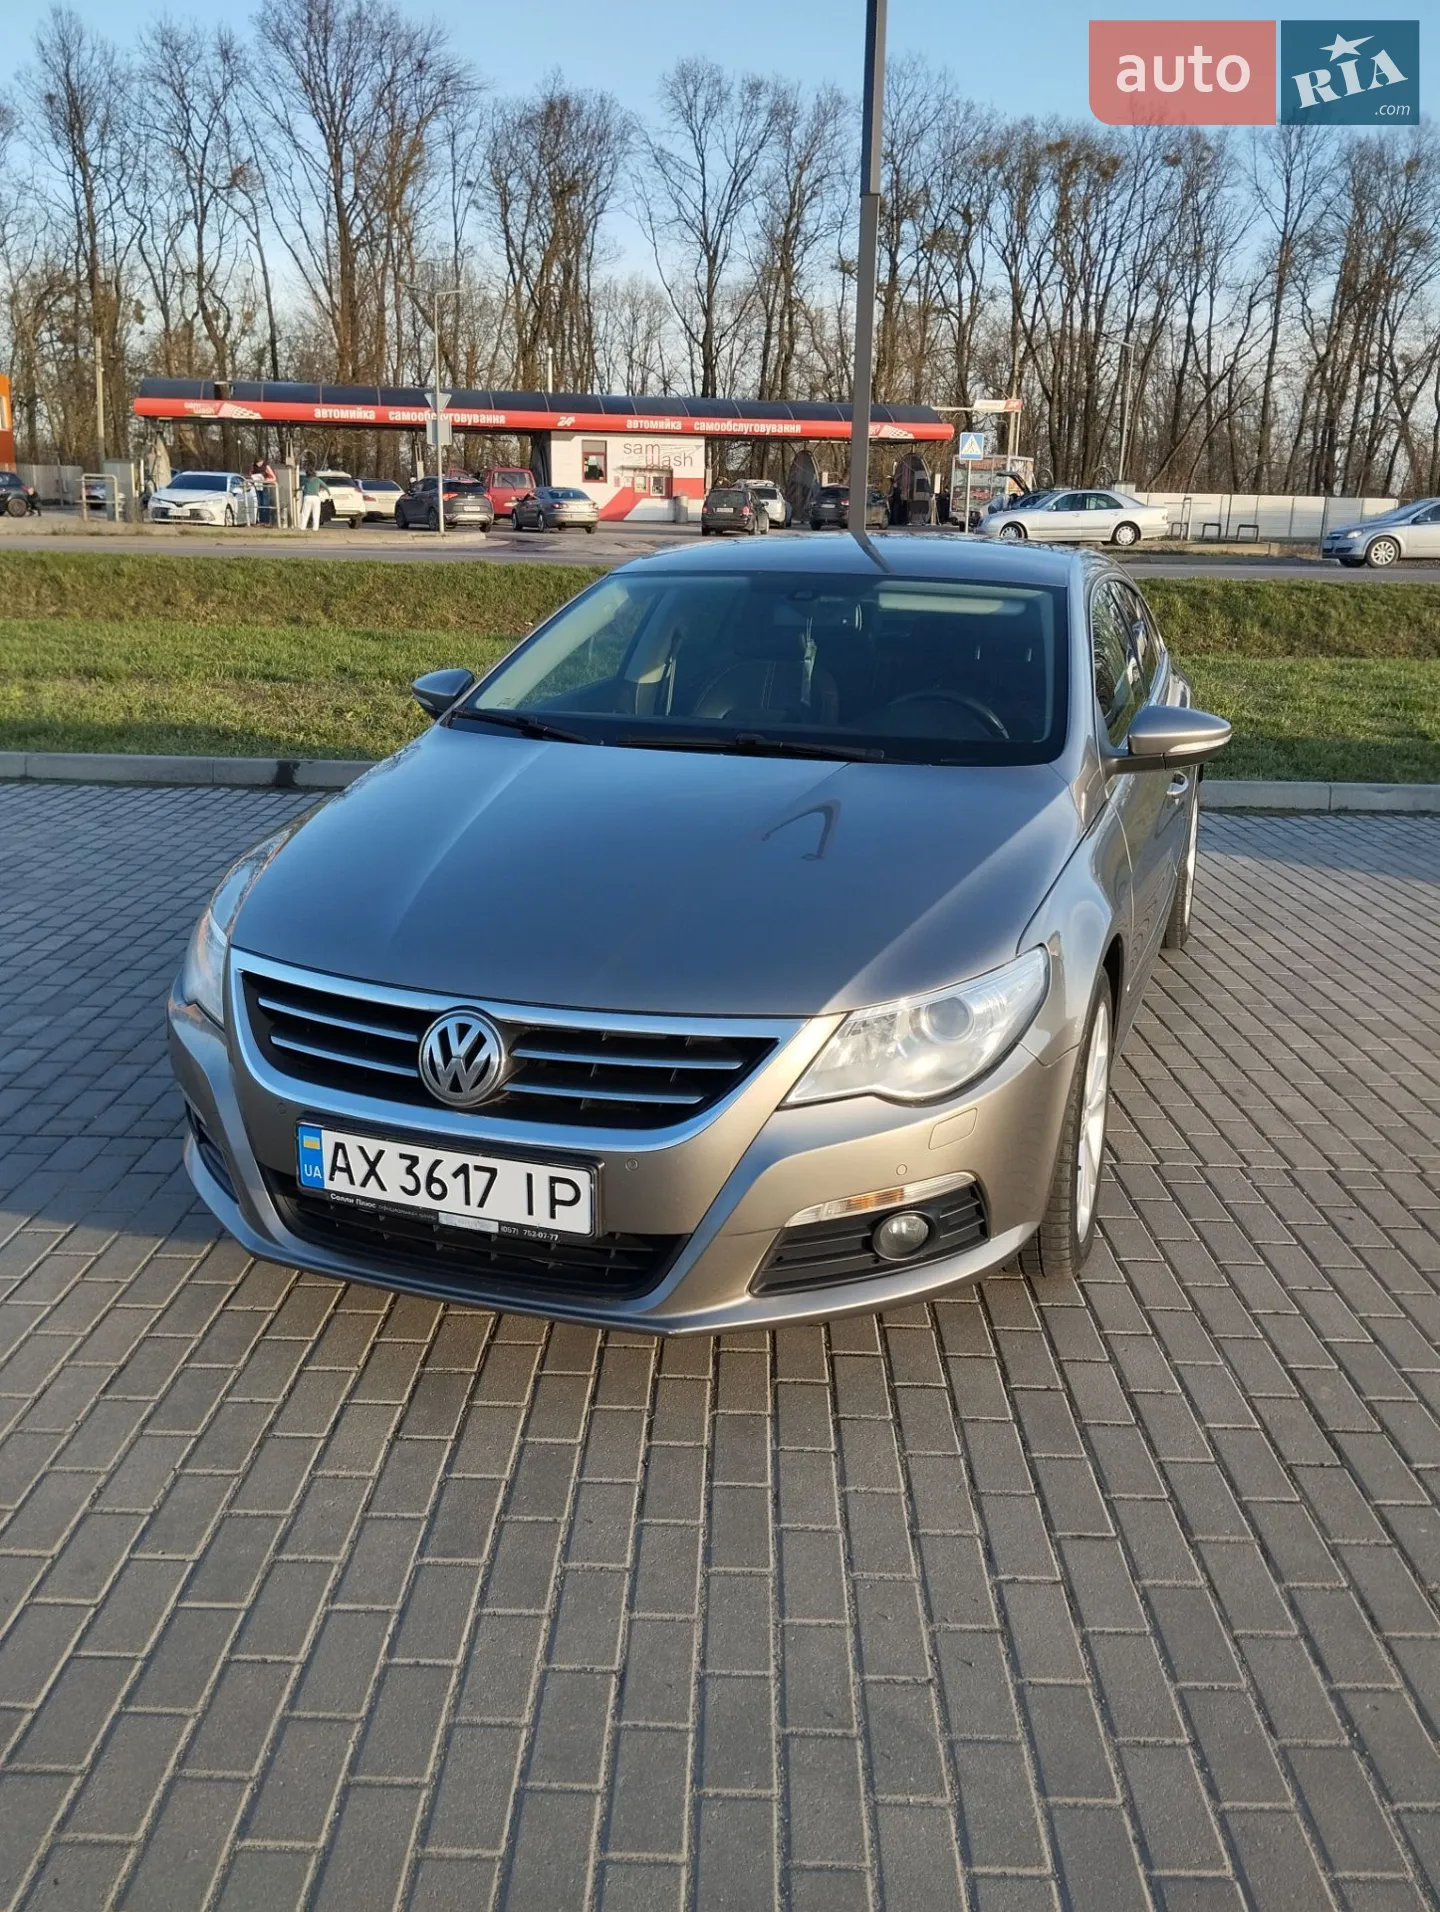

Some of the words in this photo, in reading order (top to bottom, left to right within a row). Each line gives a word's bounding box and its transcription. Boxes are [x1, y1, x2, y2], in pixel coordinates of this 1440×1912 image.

[314, 407, 376, 420] автомийка
[626, 418, 682, 431] автомийка
[693, 420, 802, 435] самообслуговування
[304, 1163, 323, 1180] UA
[328, 1141, 388, 1192] AX
[398, 1153, 498, 1209] 3617
[525, 1172, 582, 1220] IP
